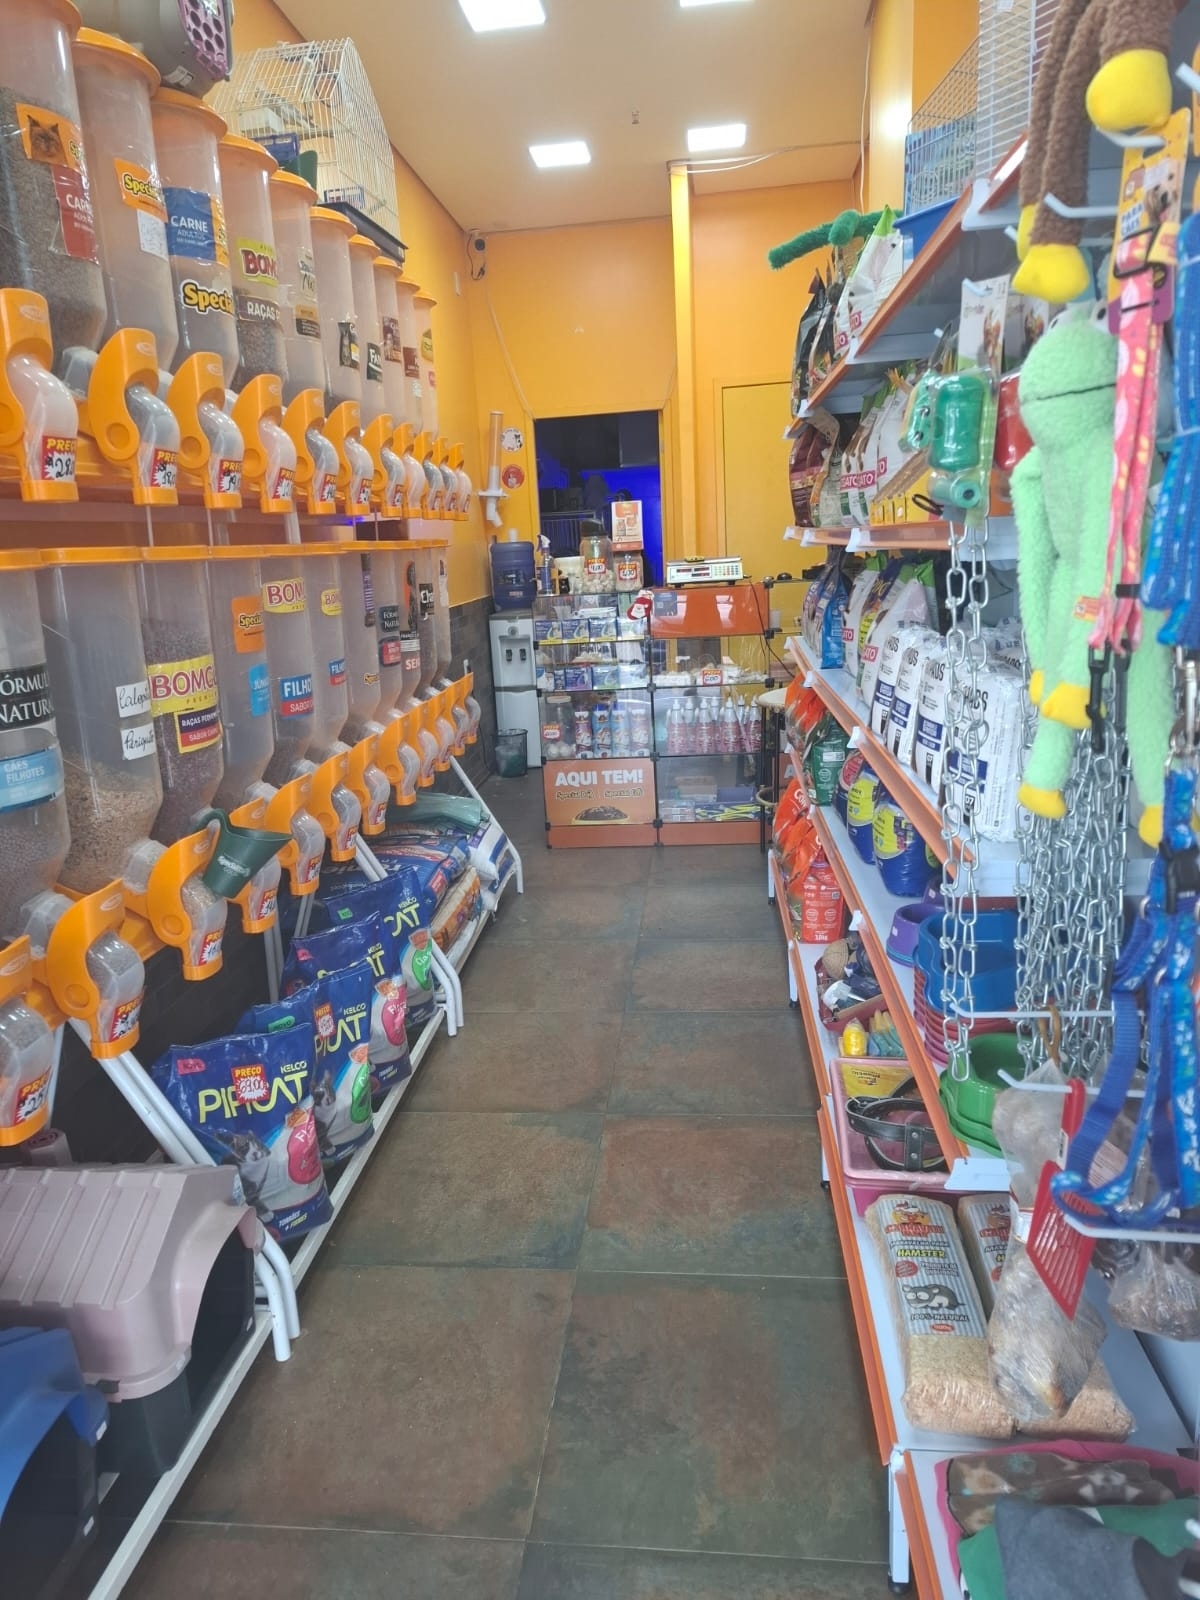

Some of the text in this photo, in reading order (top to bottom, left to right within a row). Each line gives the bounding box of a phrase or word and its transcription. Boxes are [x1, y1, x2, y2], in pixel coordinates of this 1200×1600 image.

[170, 215, 208, 233] CARNE
[554, 768, 643, 788] AQUI TEM!
[343, 1002, 366, 1015] KELCO
[280, 1061, 307, 1074] KELCO
[897, 1249, 945, 1259] HAMSTER
